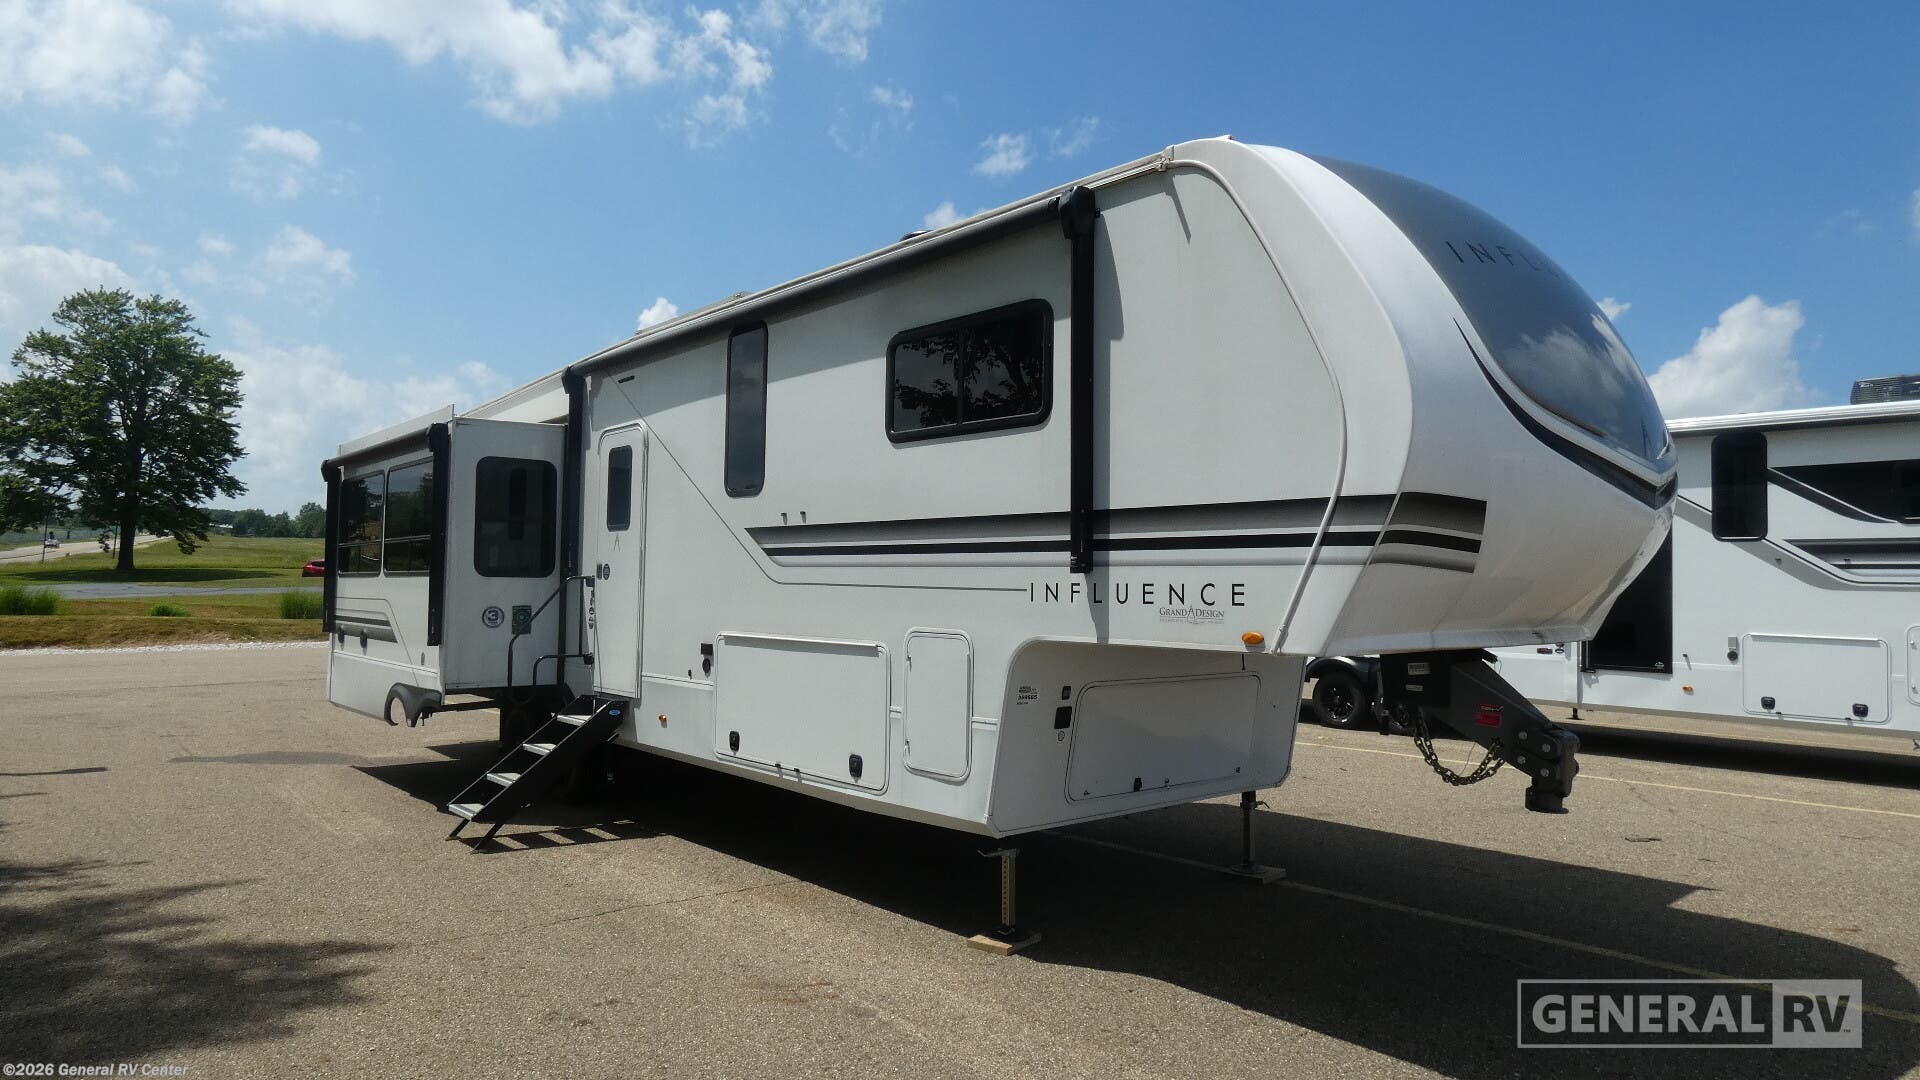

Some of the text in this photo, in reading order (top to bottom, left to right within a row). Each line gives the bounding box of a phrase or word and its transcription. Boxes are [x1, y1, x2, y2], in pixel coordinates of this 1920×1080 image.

[1030, 582, 1246, 607] INFLUENCE
[487, 609, 499, 621] 3
[1159, 607, 1225, 618] GRAND DESIGN
